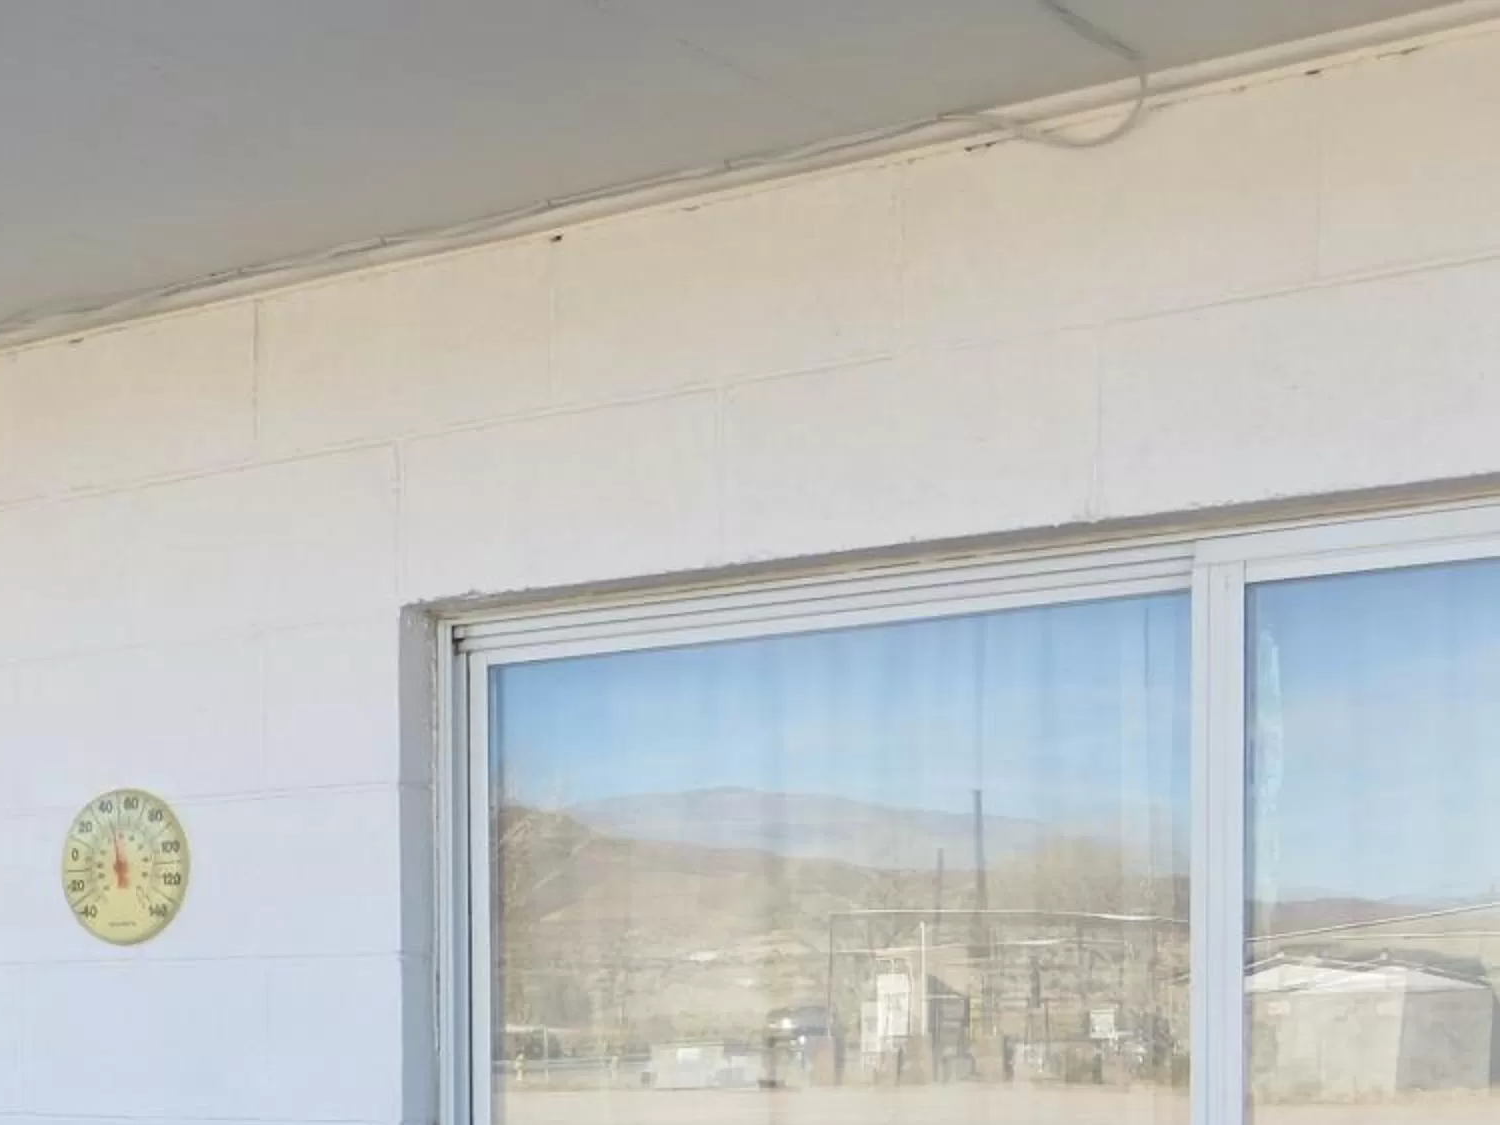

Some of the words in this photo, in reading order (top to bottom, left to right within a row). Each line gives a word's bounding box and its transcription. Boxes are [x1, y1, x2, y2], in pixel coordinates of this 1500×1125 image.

[161, 840, 181, 853] 100
[71, 848, 79, 861] 0
[163, 873, 181, 886] 120
